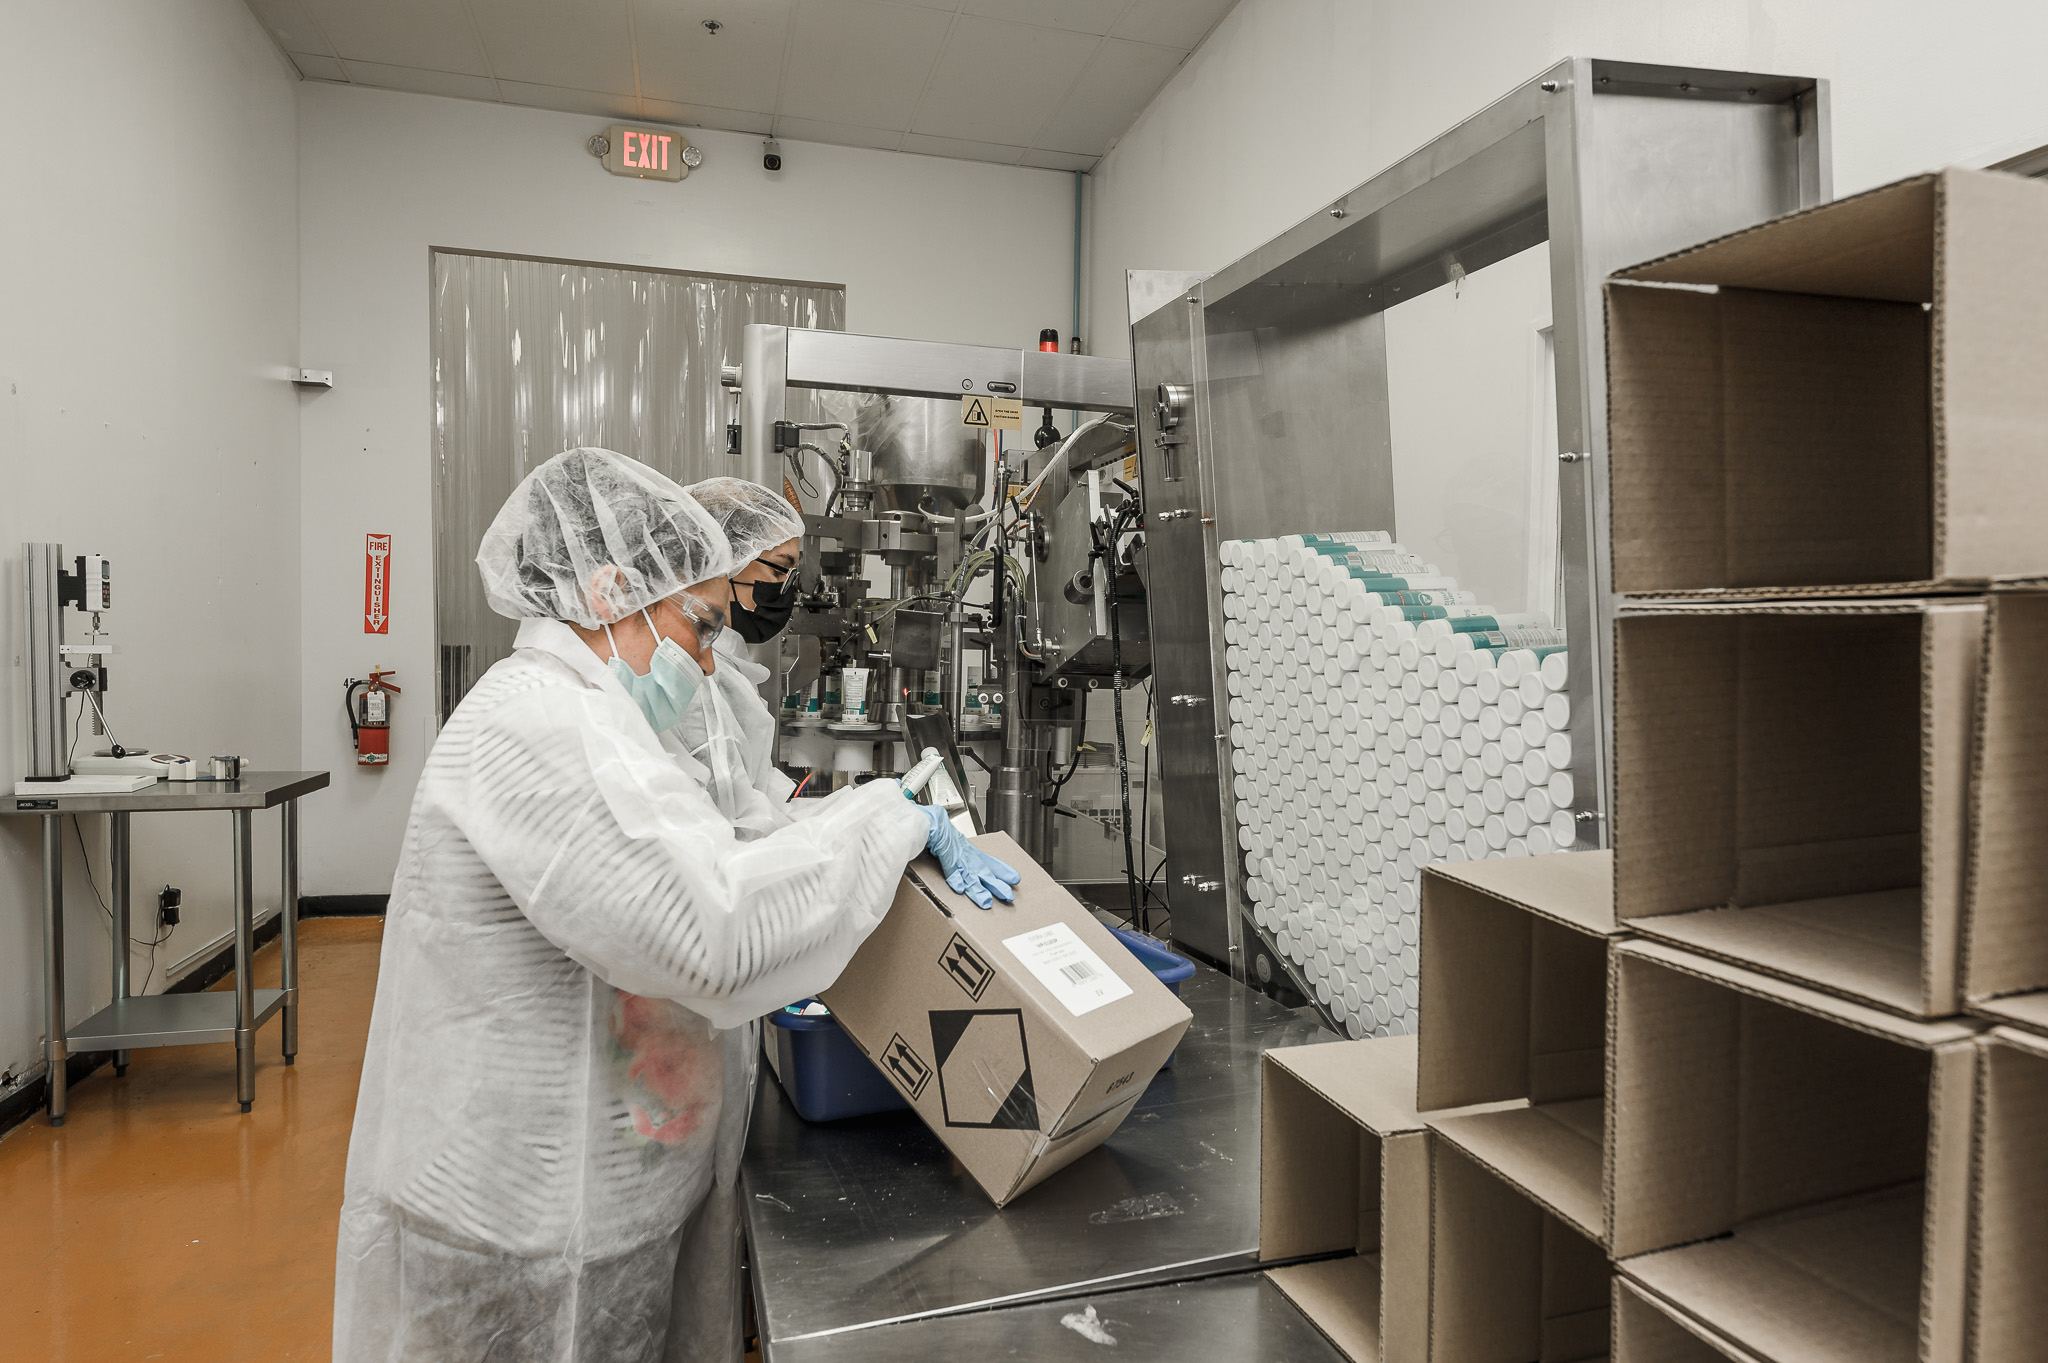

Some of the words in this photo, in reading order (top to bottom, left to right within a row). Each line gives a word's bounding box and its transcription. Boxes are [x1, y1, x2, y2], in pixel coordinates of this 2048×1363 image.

[624, 131, 671, 171] EXIT
[369, 541, 388, 551] FIRE
[373, 555, 382, 625] EXTINGUISHER
